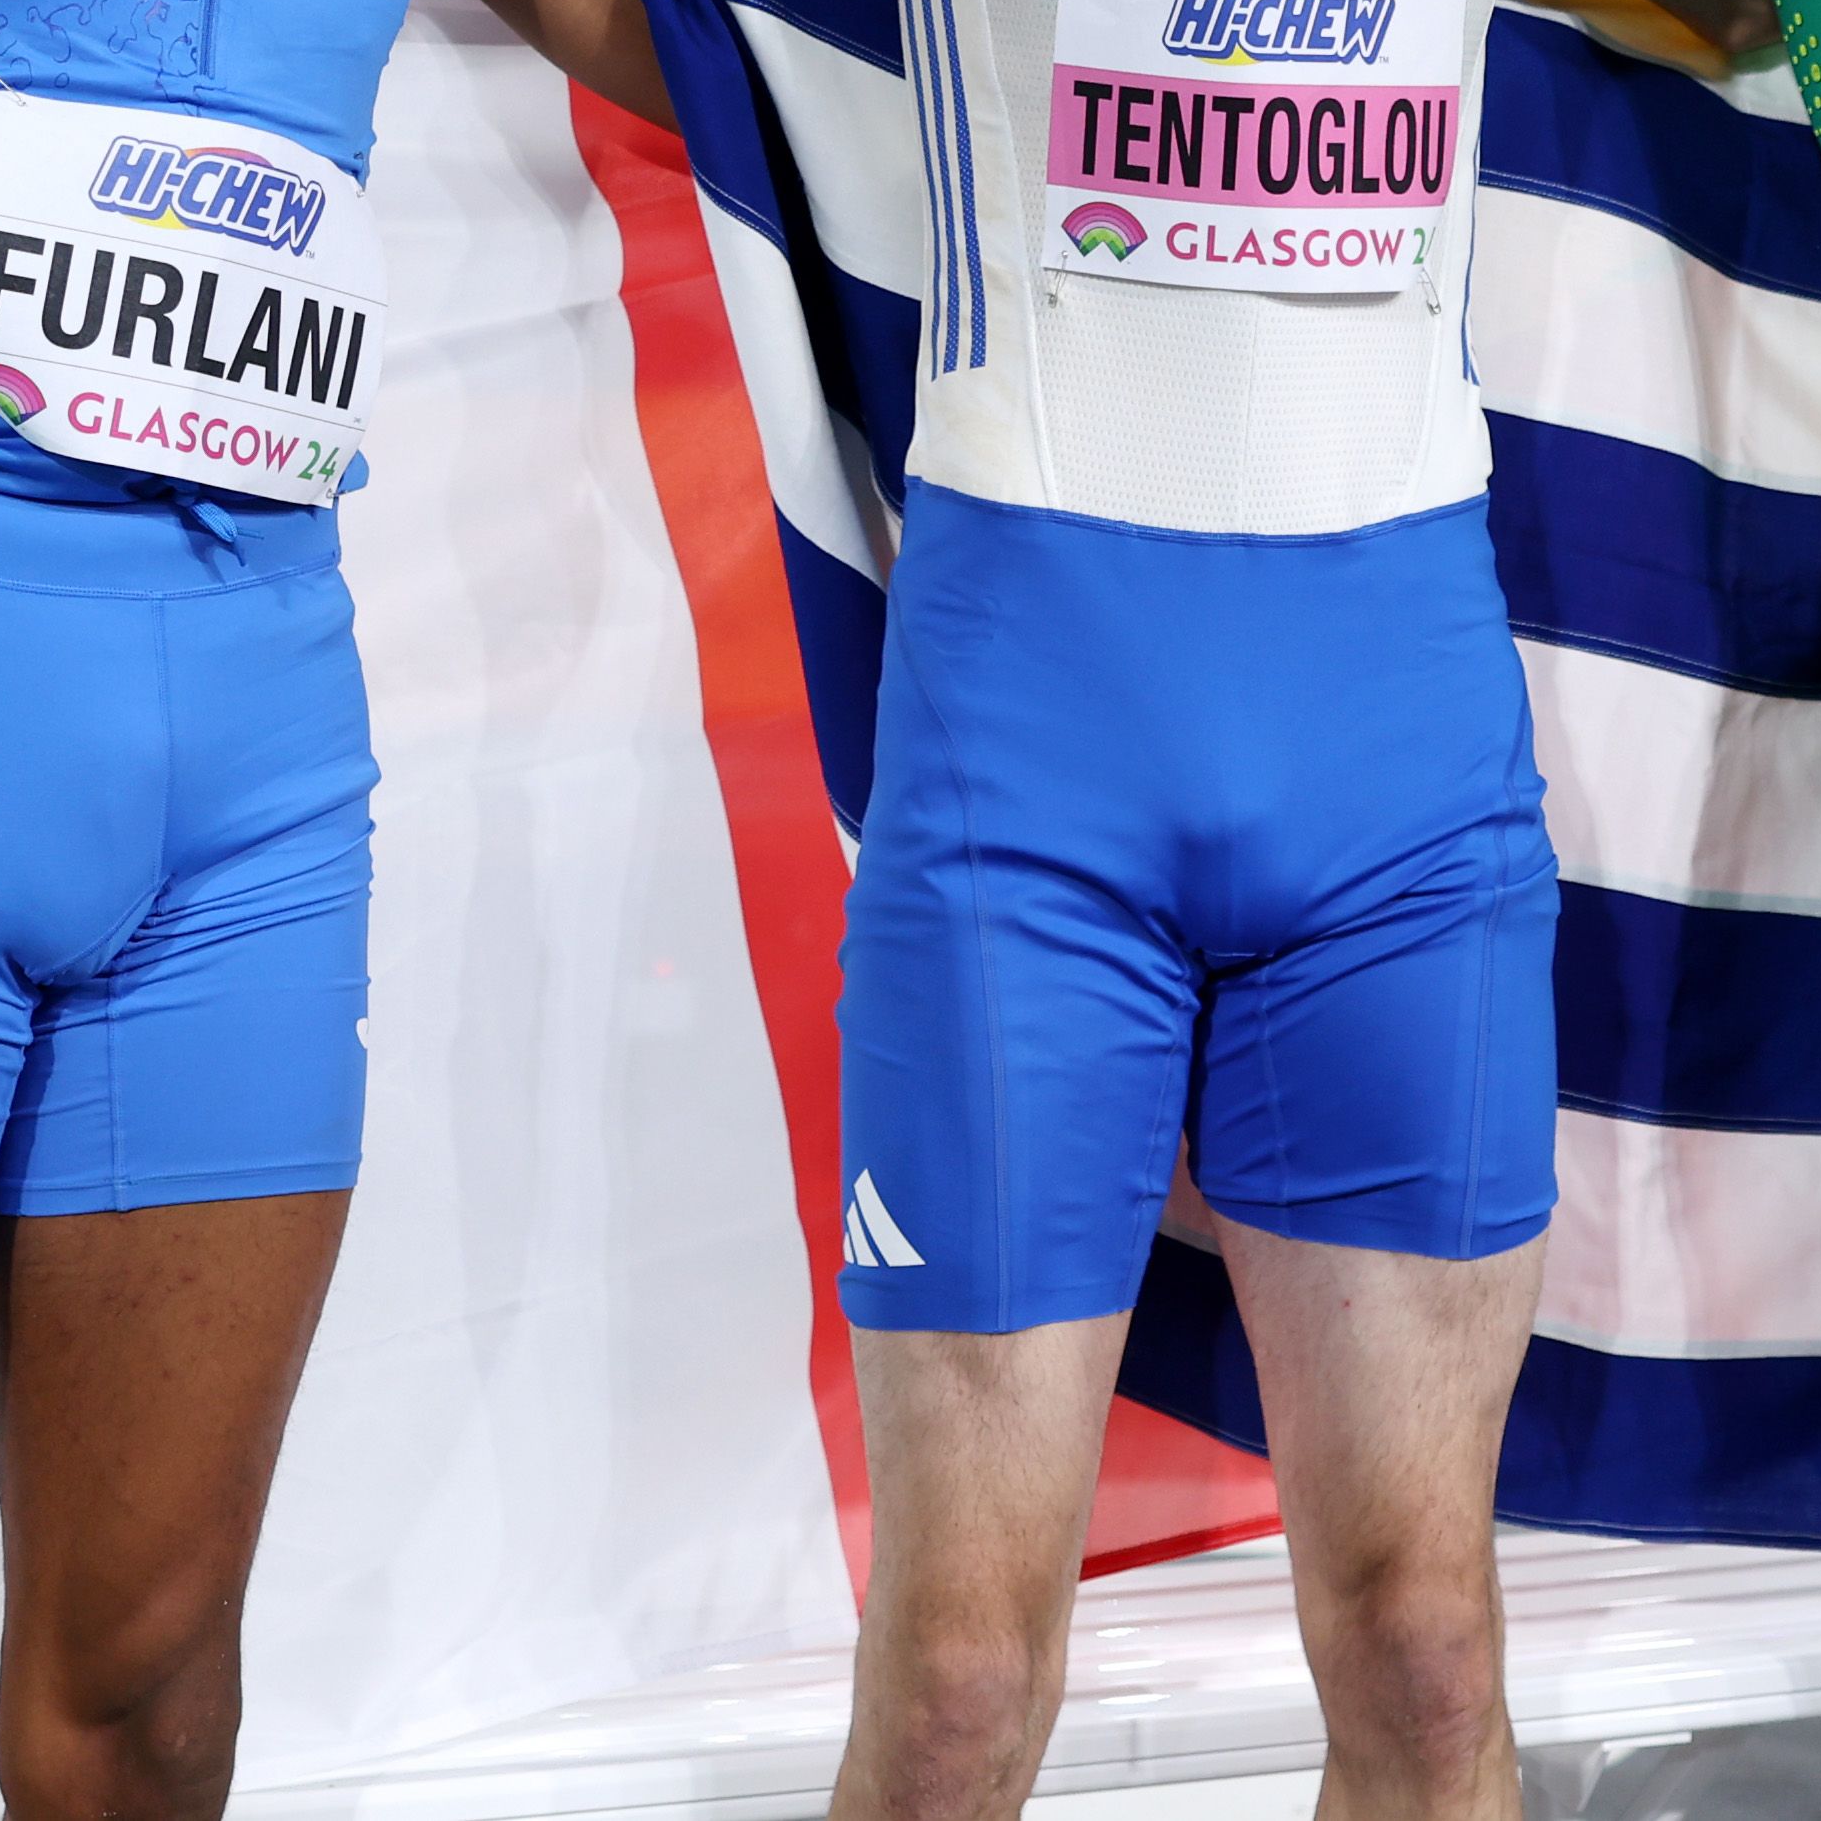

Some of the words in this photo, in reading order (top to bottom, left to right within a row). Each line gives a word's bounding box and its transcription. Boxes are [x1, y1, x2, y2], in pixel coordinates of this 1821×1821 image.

[1073, 79, 1447, 195] TENTOGLOU
[89, 135, 326, 257] HI-CHEW
[1165, 221, 1405, 267] GLASGOW
[67, 391, 300, 474] GLASGOW
[297, 439, 340, 484] 24
